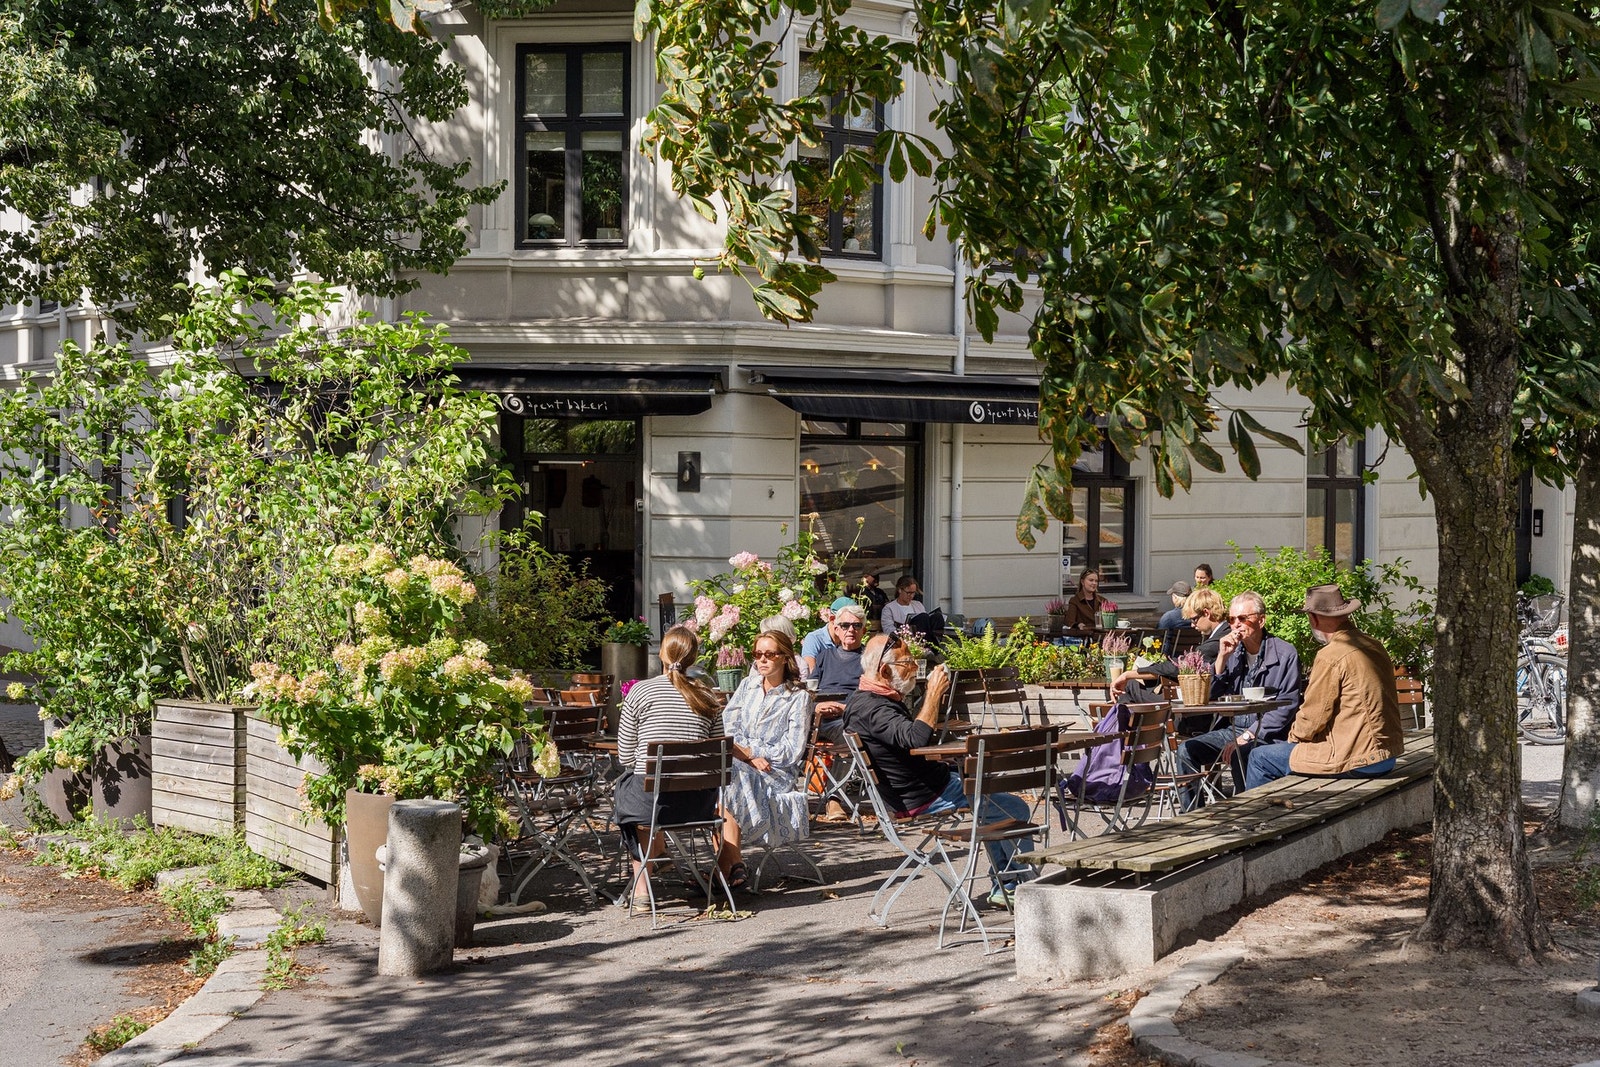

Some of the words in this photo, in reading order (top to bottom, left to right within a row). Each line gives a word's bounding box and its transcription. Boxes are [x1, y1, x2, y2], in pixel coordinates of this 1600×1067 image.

[526, 395, 563, 416] åpent
[567, 399, 608, 412] bakeri
[987, 403, 1015, 424] åpent
[1016, 407, 1038, 420] bake
